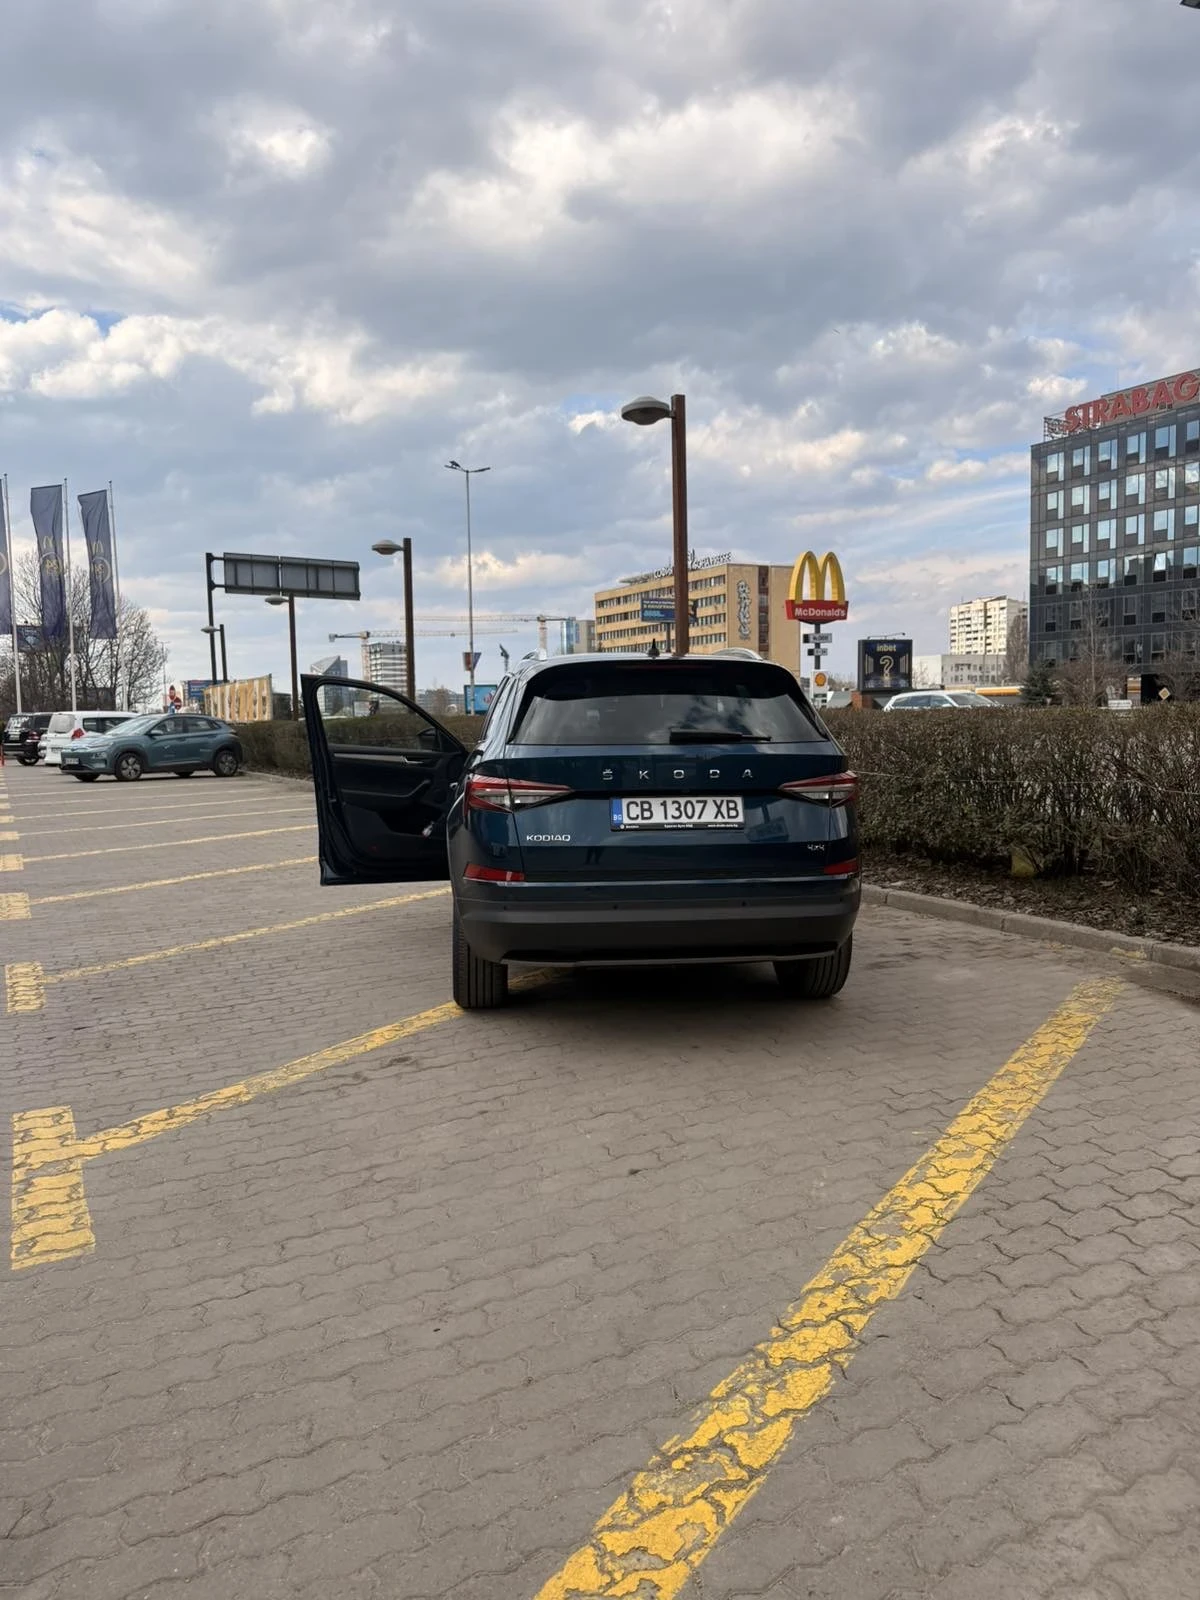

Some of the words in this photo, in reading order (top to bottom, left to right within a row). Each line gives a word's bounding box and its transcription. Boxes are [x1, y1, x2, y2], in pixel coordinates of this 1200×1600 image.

[1064, 373, 1200, 433] STRABAG
[794, 607, 846, 617] McDonald's
[876, 643, 897, 652] inbet
[626, 799, 654, 821] CB
[660, 799, 707, 820] 1307
[712, 799, 740, 820] XB
[526, 834, 571, 842] KODIAQ
